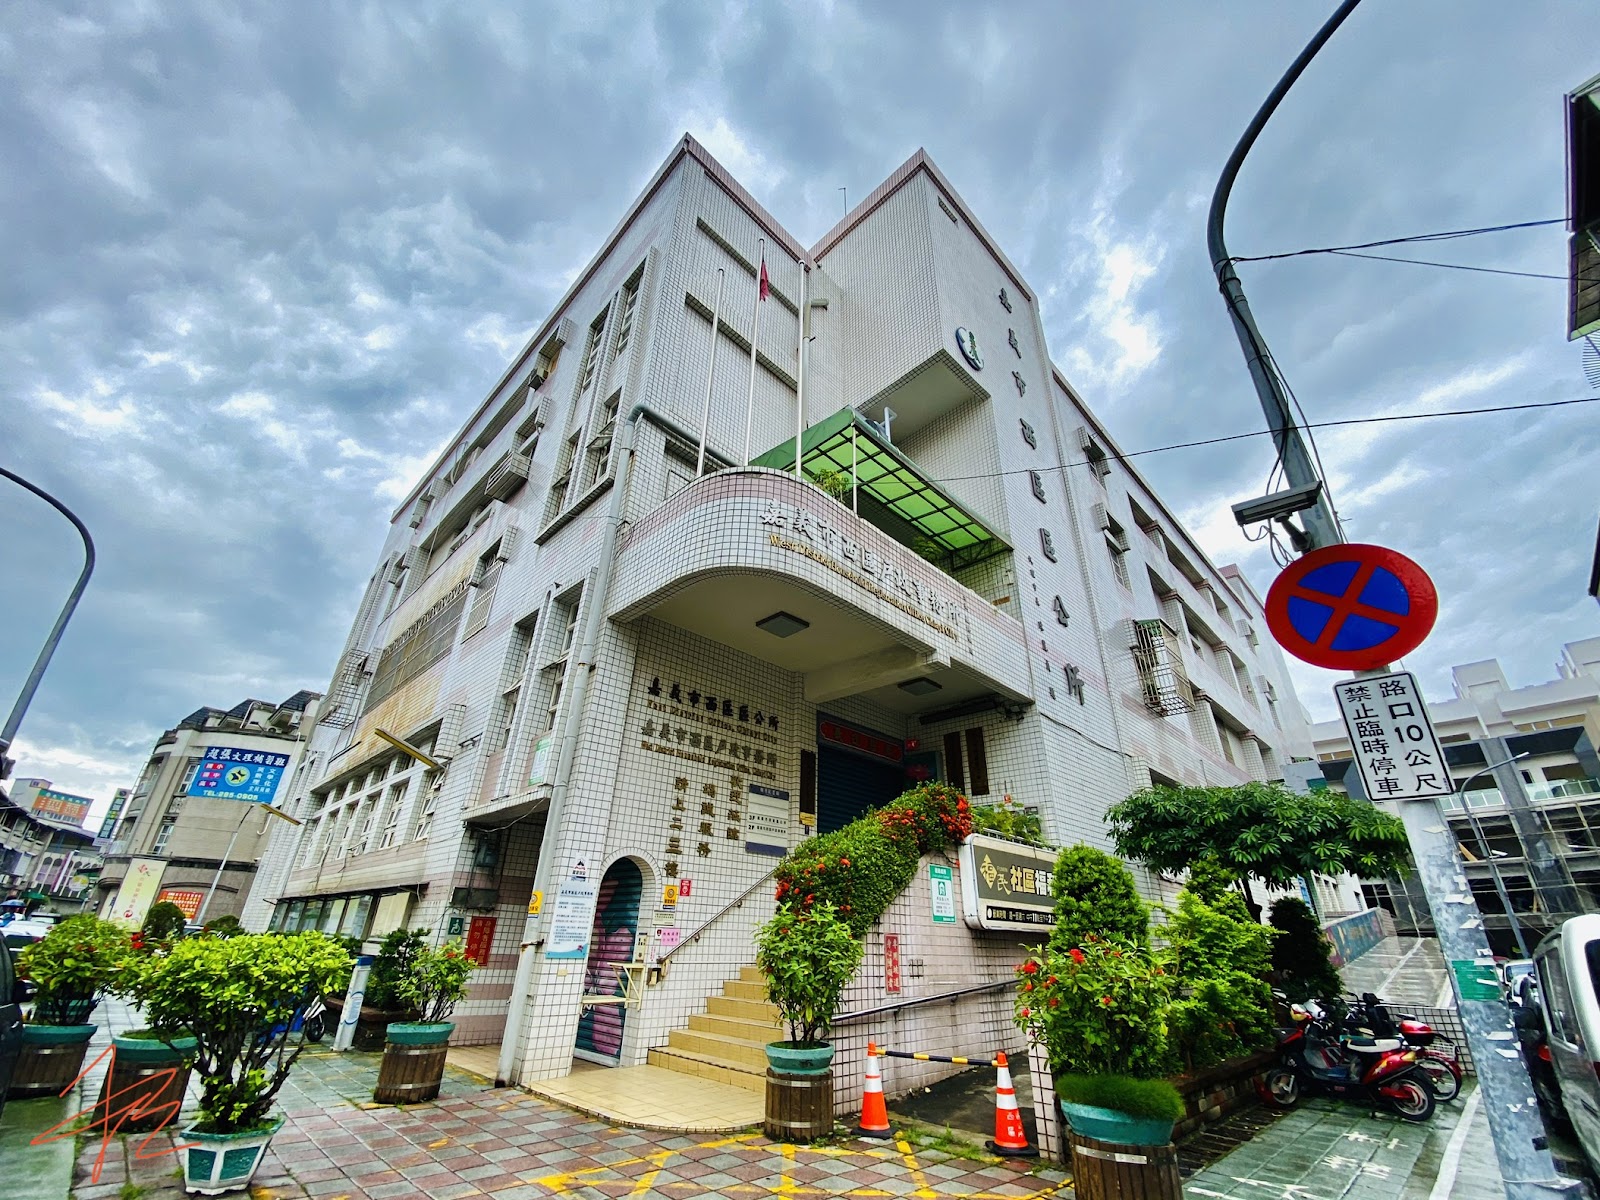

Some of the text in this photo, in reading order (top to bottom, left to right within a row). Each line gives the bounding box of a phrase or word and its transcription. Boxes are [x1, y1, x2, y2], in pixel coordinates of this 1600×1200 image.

[769, 533, 797, 554] West
[1344, 685, 1404, 796] 禁止臨時停車
[1378, 680, 1442, 792] 路口10公尺
